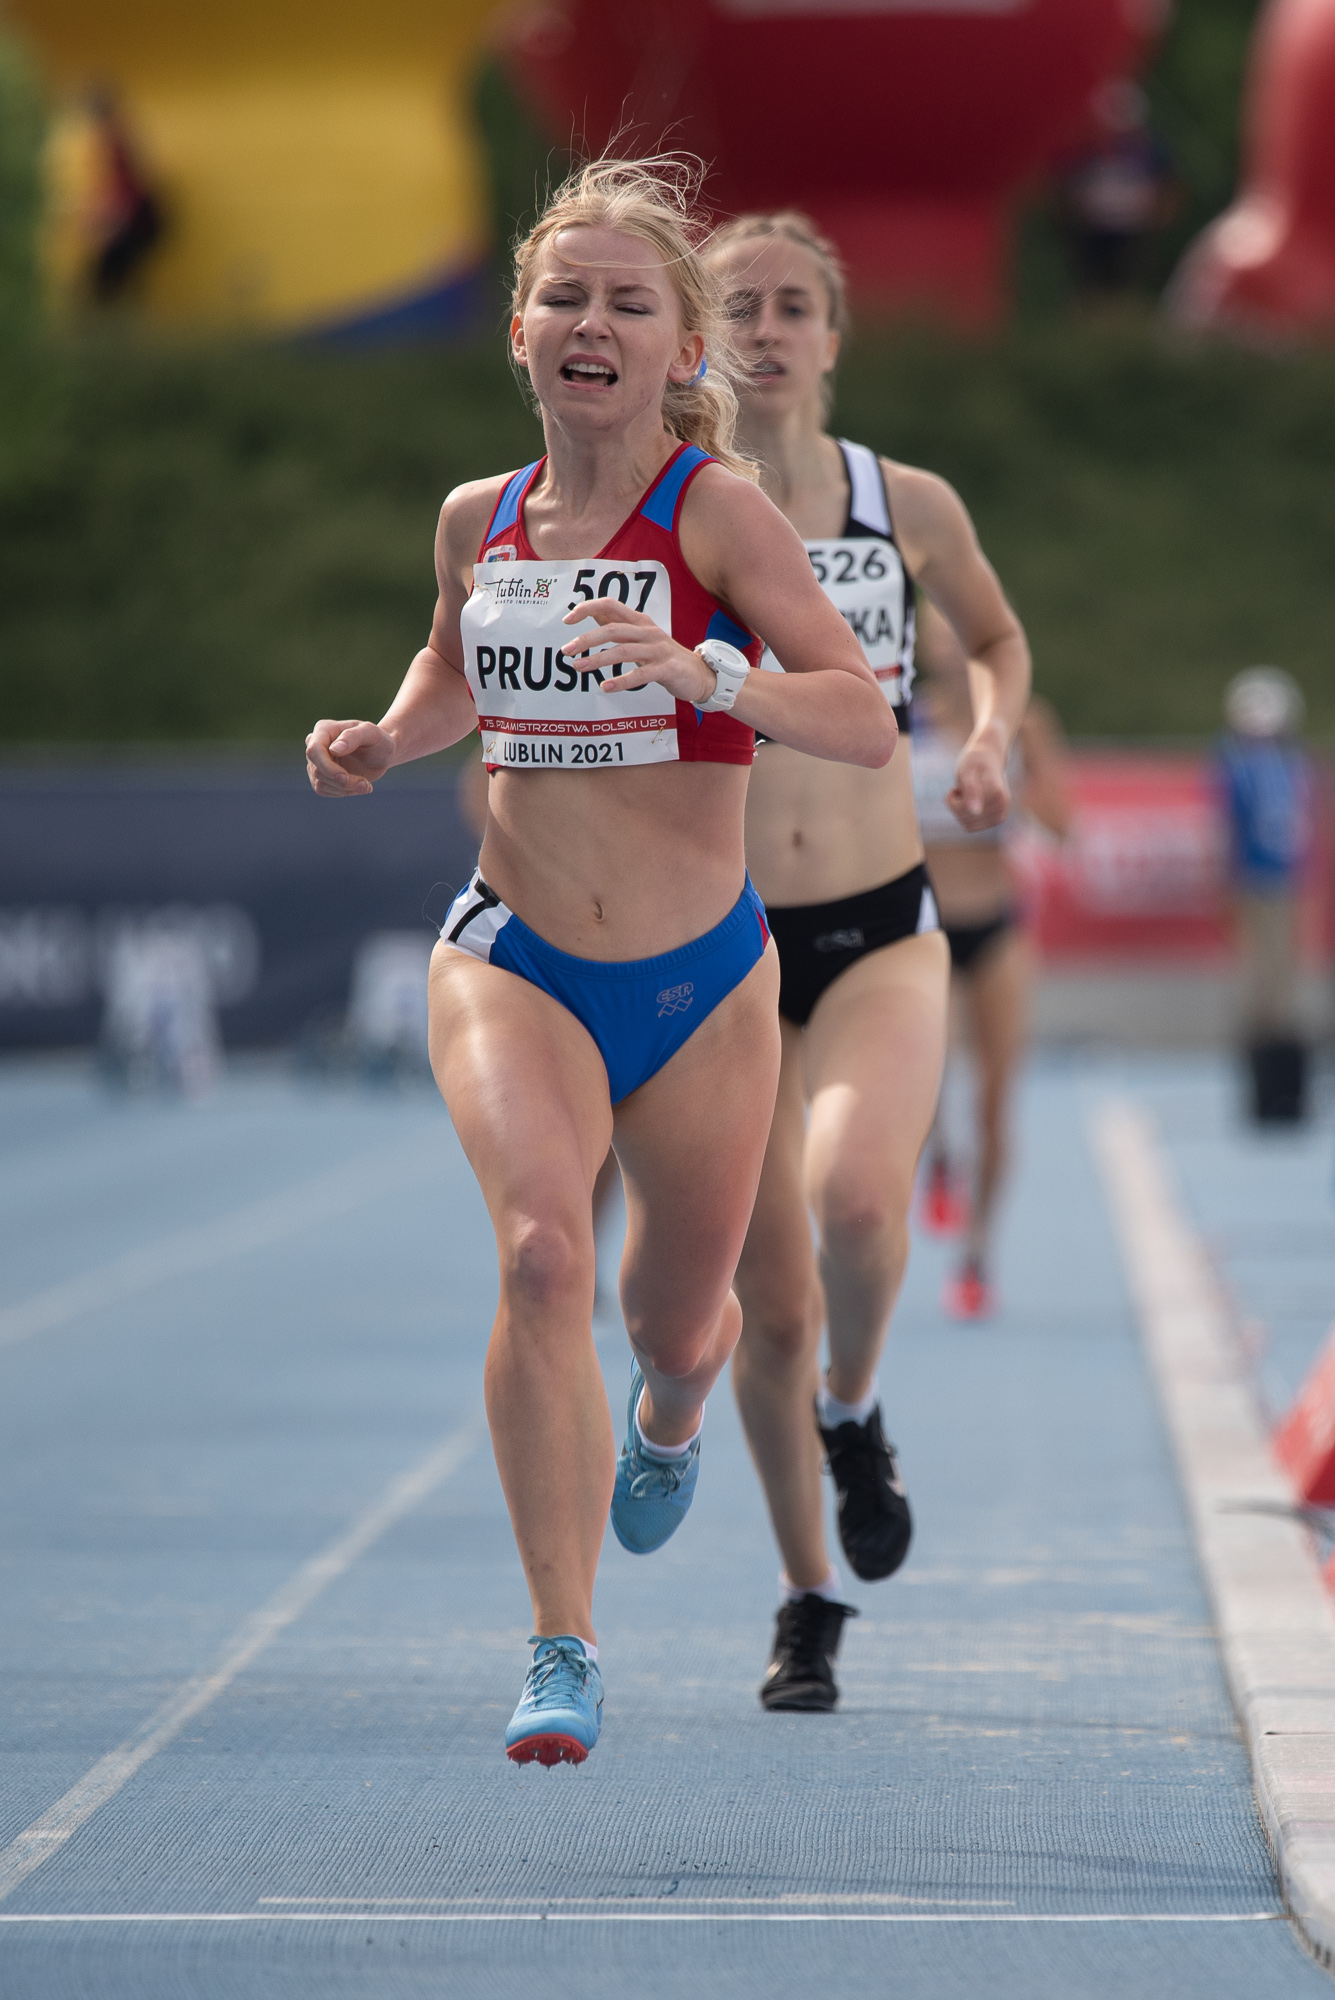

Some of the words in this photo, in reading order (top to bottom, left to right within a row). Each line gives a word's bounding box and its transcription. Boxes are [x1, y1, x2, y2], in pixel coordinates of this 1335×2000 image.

[807, 548, 886, 583] 526
[567, 569, 657, 613] 507
[484, 719, 495, 728] 75.
[510, 722, 589, 733] MISTRZOSTWA
[592, 722, 637, 733] POLSKI
[640, 718, 667, 728] U20
[504, 741, 563, 764] LUBLIN
[570, 742, 624, 764] 2021
